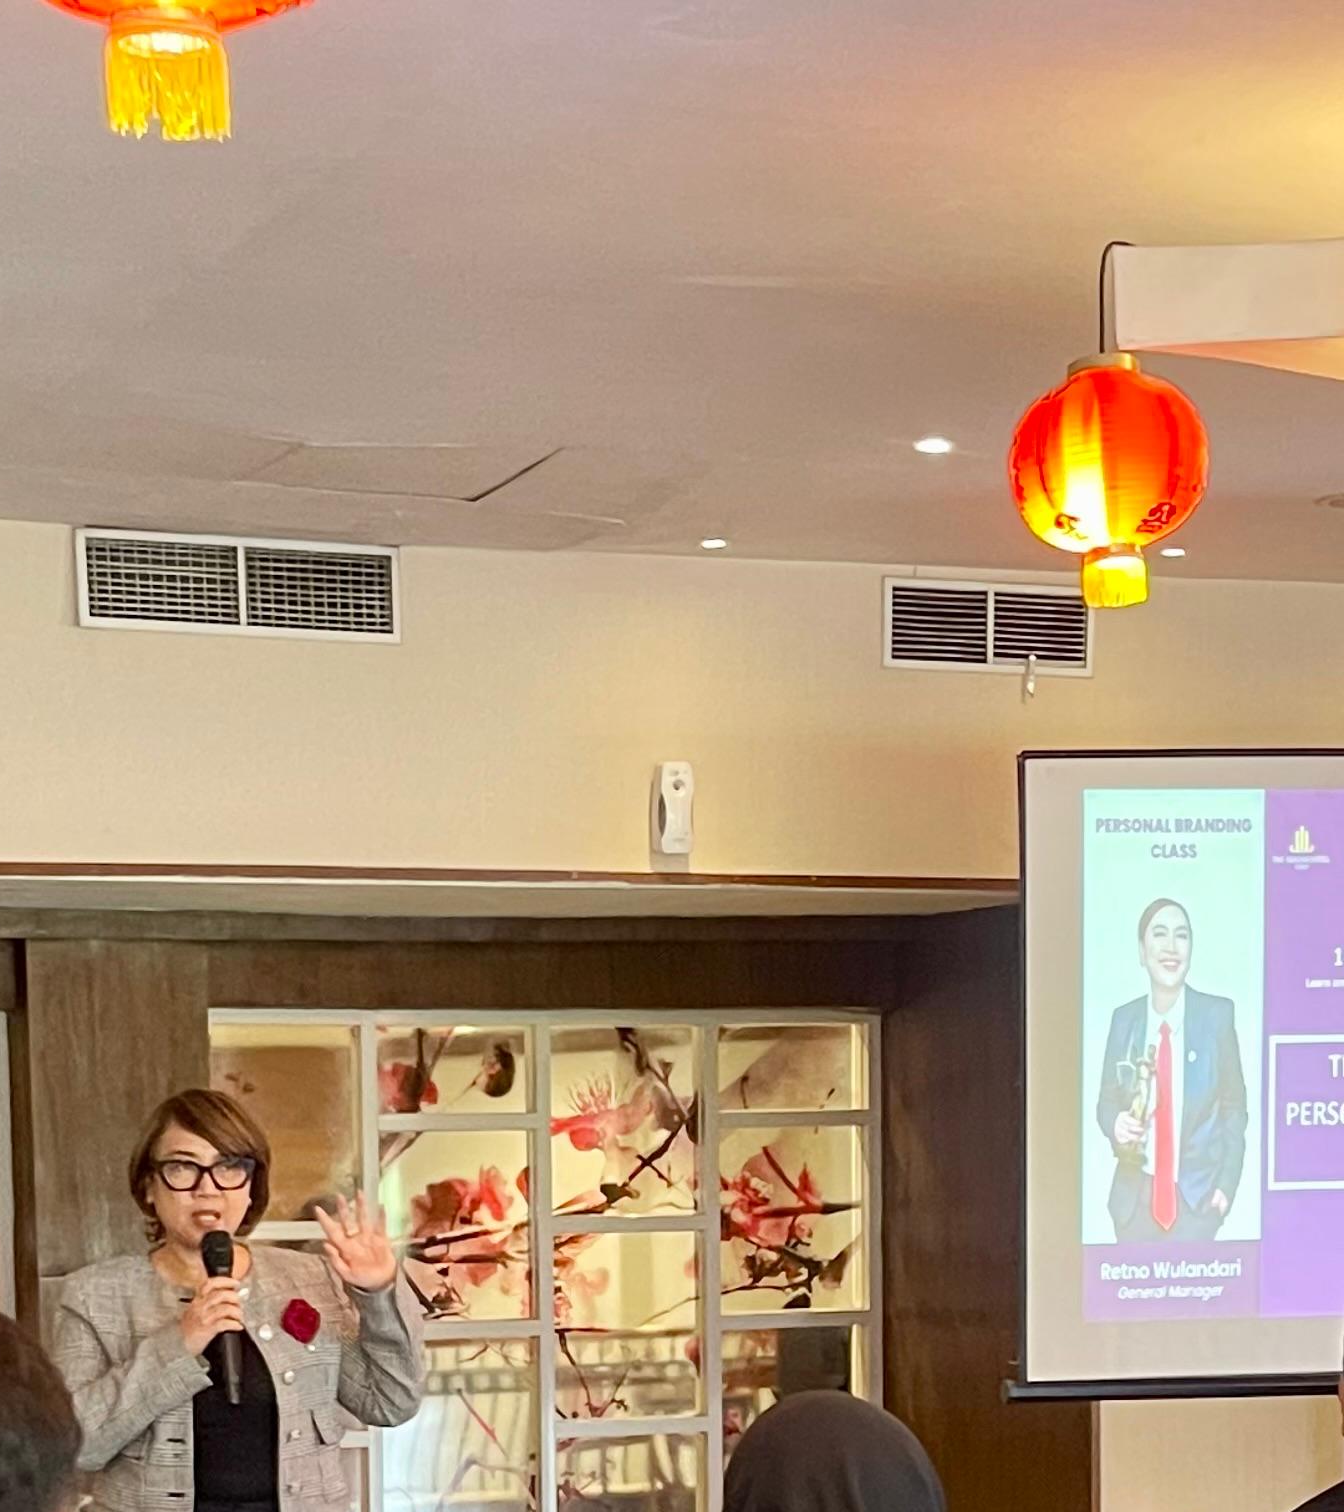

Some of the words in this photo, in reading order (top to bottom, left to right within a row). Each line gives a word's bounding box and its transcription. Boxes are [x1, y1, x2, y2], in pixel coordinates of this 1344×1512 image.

[1095, 818, 1171, 833] PERSONAL
[1174, 818, 1253, 833] BRANDING
[1150, 843, 1198, 859] CLASS
[1100, 1262, 1150, 1280] Retno
[1153, 1257, 1242, 1279] Wulandari
[1117, 1285, 1167, 1299] General
[1168, 1284, 1225, 1301] Manager
